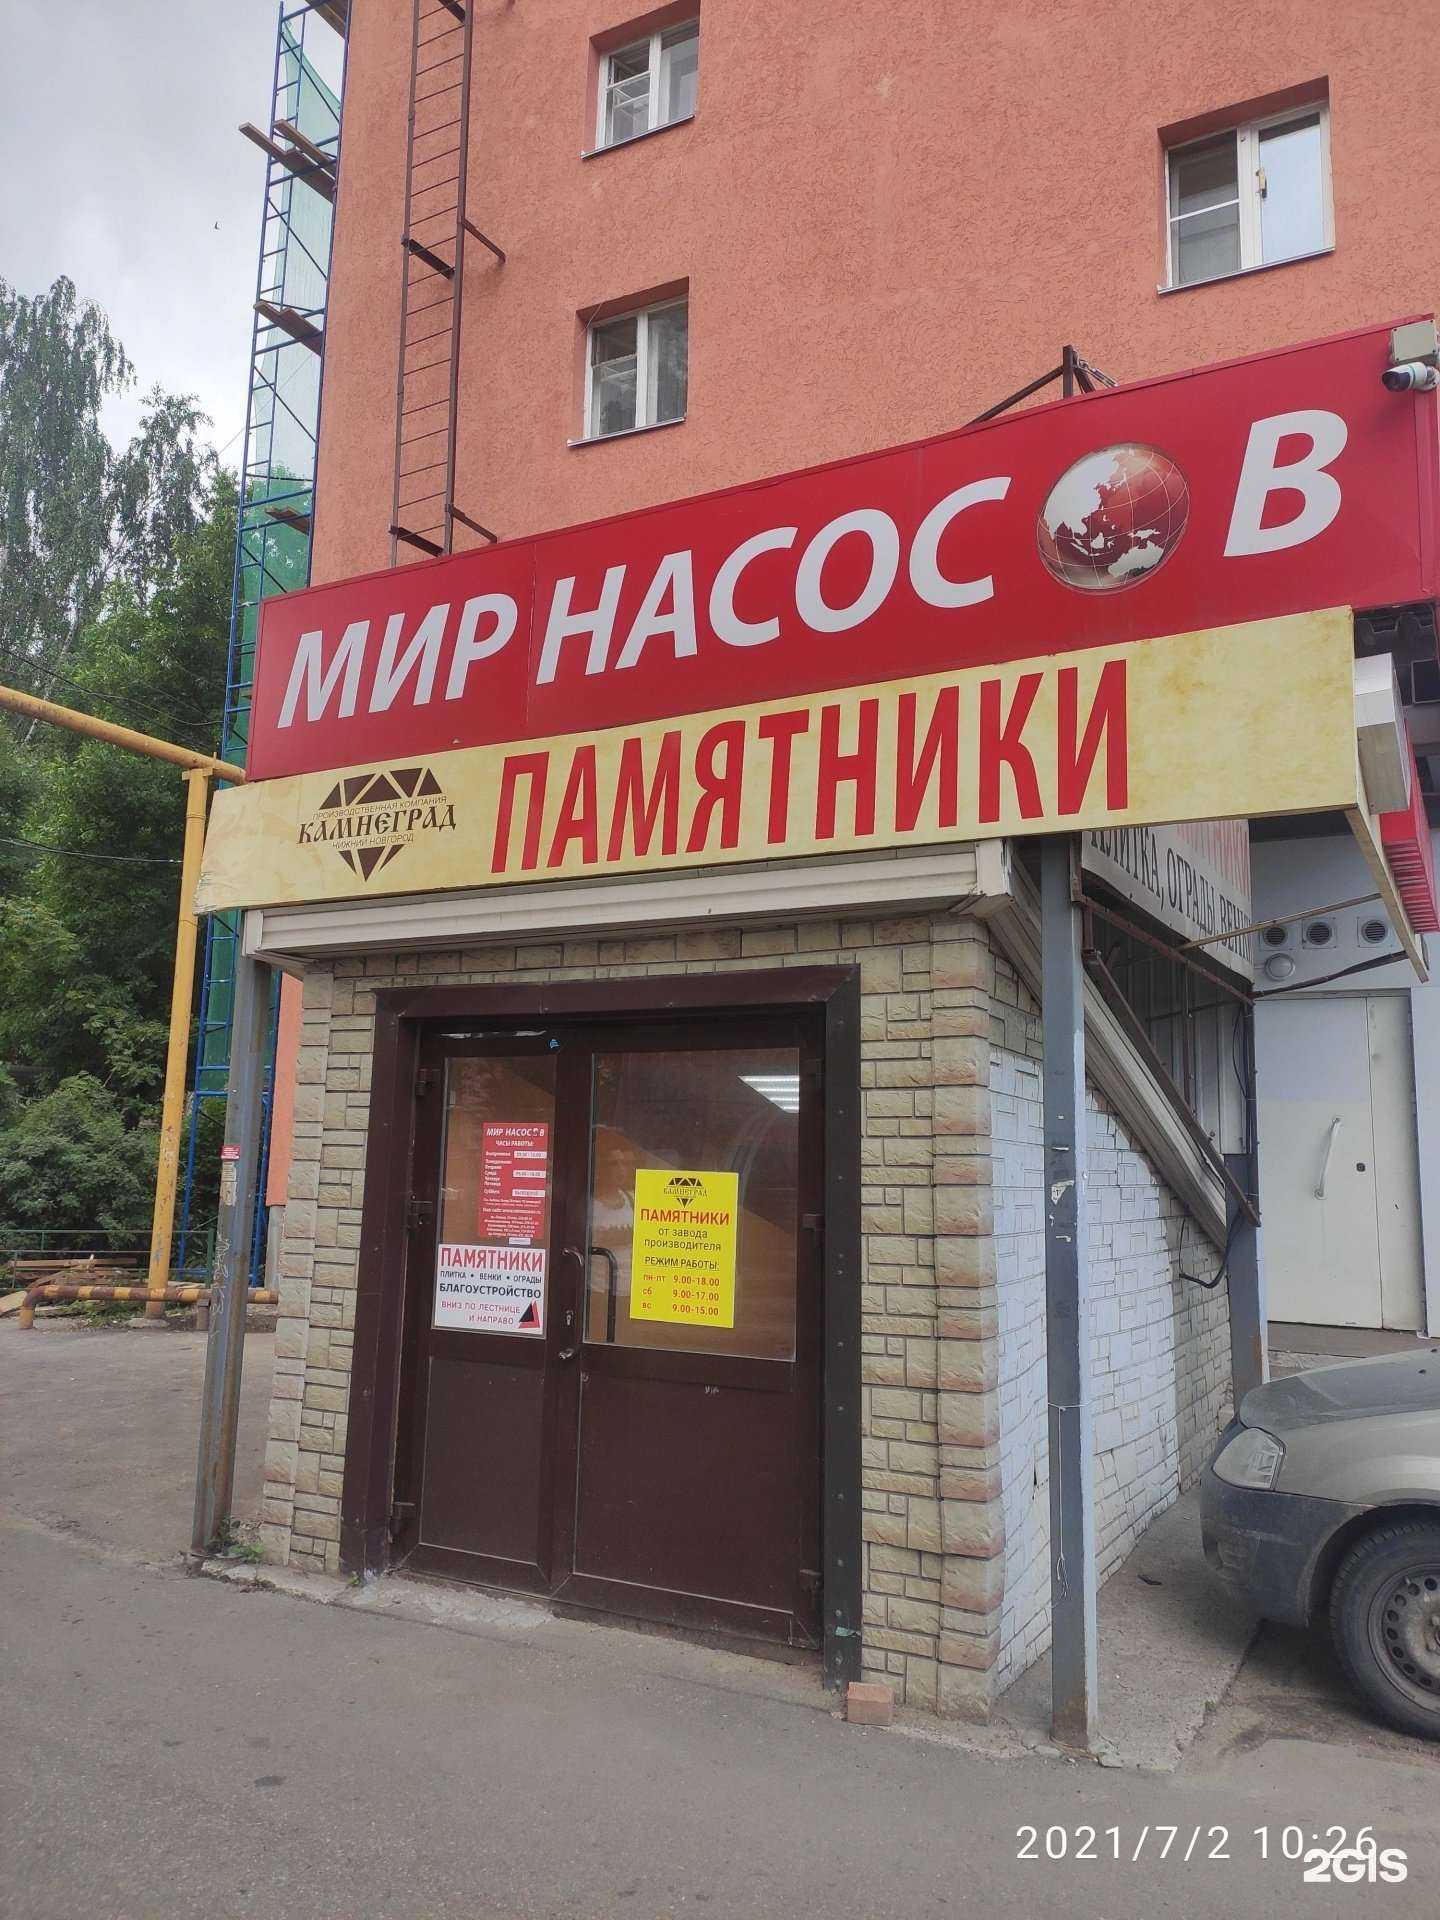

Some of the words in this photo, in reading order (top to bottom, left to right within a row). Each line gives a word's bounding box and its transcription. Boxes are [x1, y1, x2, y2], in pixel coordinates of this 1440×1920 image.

[277, 593, 518, 729] МИР
[491, 658, 1129, 874] ПАМЯТНИКИ
[313, 803, 398, 820] ПРОИЗВОДСТВЕННАЯ
[399, 795, 447, 808] КОМПАНИЯ
[298, 804, 457, 844] КАМНЕГРАД
[332, 837, 368, 849] НИЖНИЙ
[370, 833, 414, 847] НОВГОРОД
[1091, 826, 1166, 912] ИТКА,
[486, 1127, 504, 1137] МИР
[640, 1208, 730, 1225] ПАМЯТНИКИ
[658, 1228, 670, 1236] от
[672, 1229, 708, 1240] завода
[644, 1239, 721, 1251] производителя
[440, 1247, 543, 1273] ПАМЯТНИКИ
[645, 1256, 679, 1267] РЕЖИМ
[440, 1271, 466, 1279] ПЛИТКА
[479, 1273, 502, 1281] ВЕНКИ
[513, 1275, 542, 1284] ОГРАДЫ
[439, 1283, 541, 1298] БЛАГОУСТРОЙСТВО
[642, 1287, 653, 1295] сб
[441, 1301, 462, 1309] ВНИЗ
[464, 1302, 476, 1310] ПО
[478, 1303, 521, 1314] ЛЕСТНИЦЕ
[477, 1316, 514, 1325] НАПРАВО
